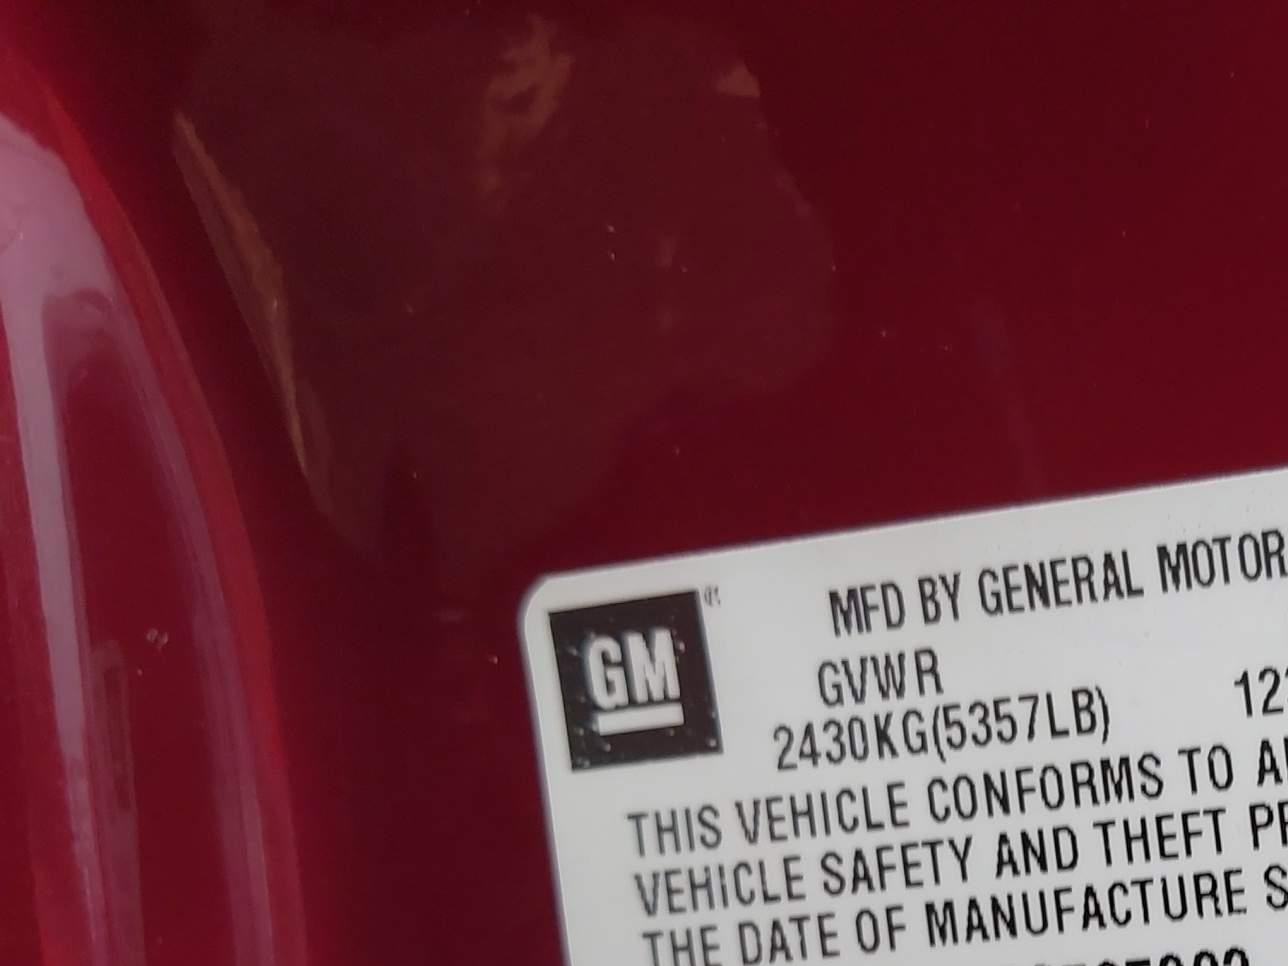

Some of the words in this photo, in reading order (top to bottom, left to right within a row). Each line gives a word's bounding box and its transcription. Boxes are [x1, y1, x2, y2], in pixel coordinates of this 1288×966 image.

[828, 580, 906, 638] MFD
[917, 571, 961, 625] BY
[977, 549, 1145, 617] GENERAL
[586, 626, 682, 712] GM
[817, 647, 944, 708] GVWR
[772, 685, 1110, 772] 2430KG(5357LB)
[626, 804, 722, 857] THIS
[734, 781, 910, 845] VEHICLE
[926, 751, 1164, 824] CONFORMS
[1177, 743, 1234, 796] TO
[633, 855, 807, 917] VEHICLE
[820, 835, 973, 897] SAFETY
[995, 824, 1079, 879] AND
[1092, 807, 1227, 868] THEFT
[737, 912, 841, 966] DATE
[854, 904, 906, 954] OF
[924, 867, 1248, 948] MANUFACTURE
